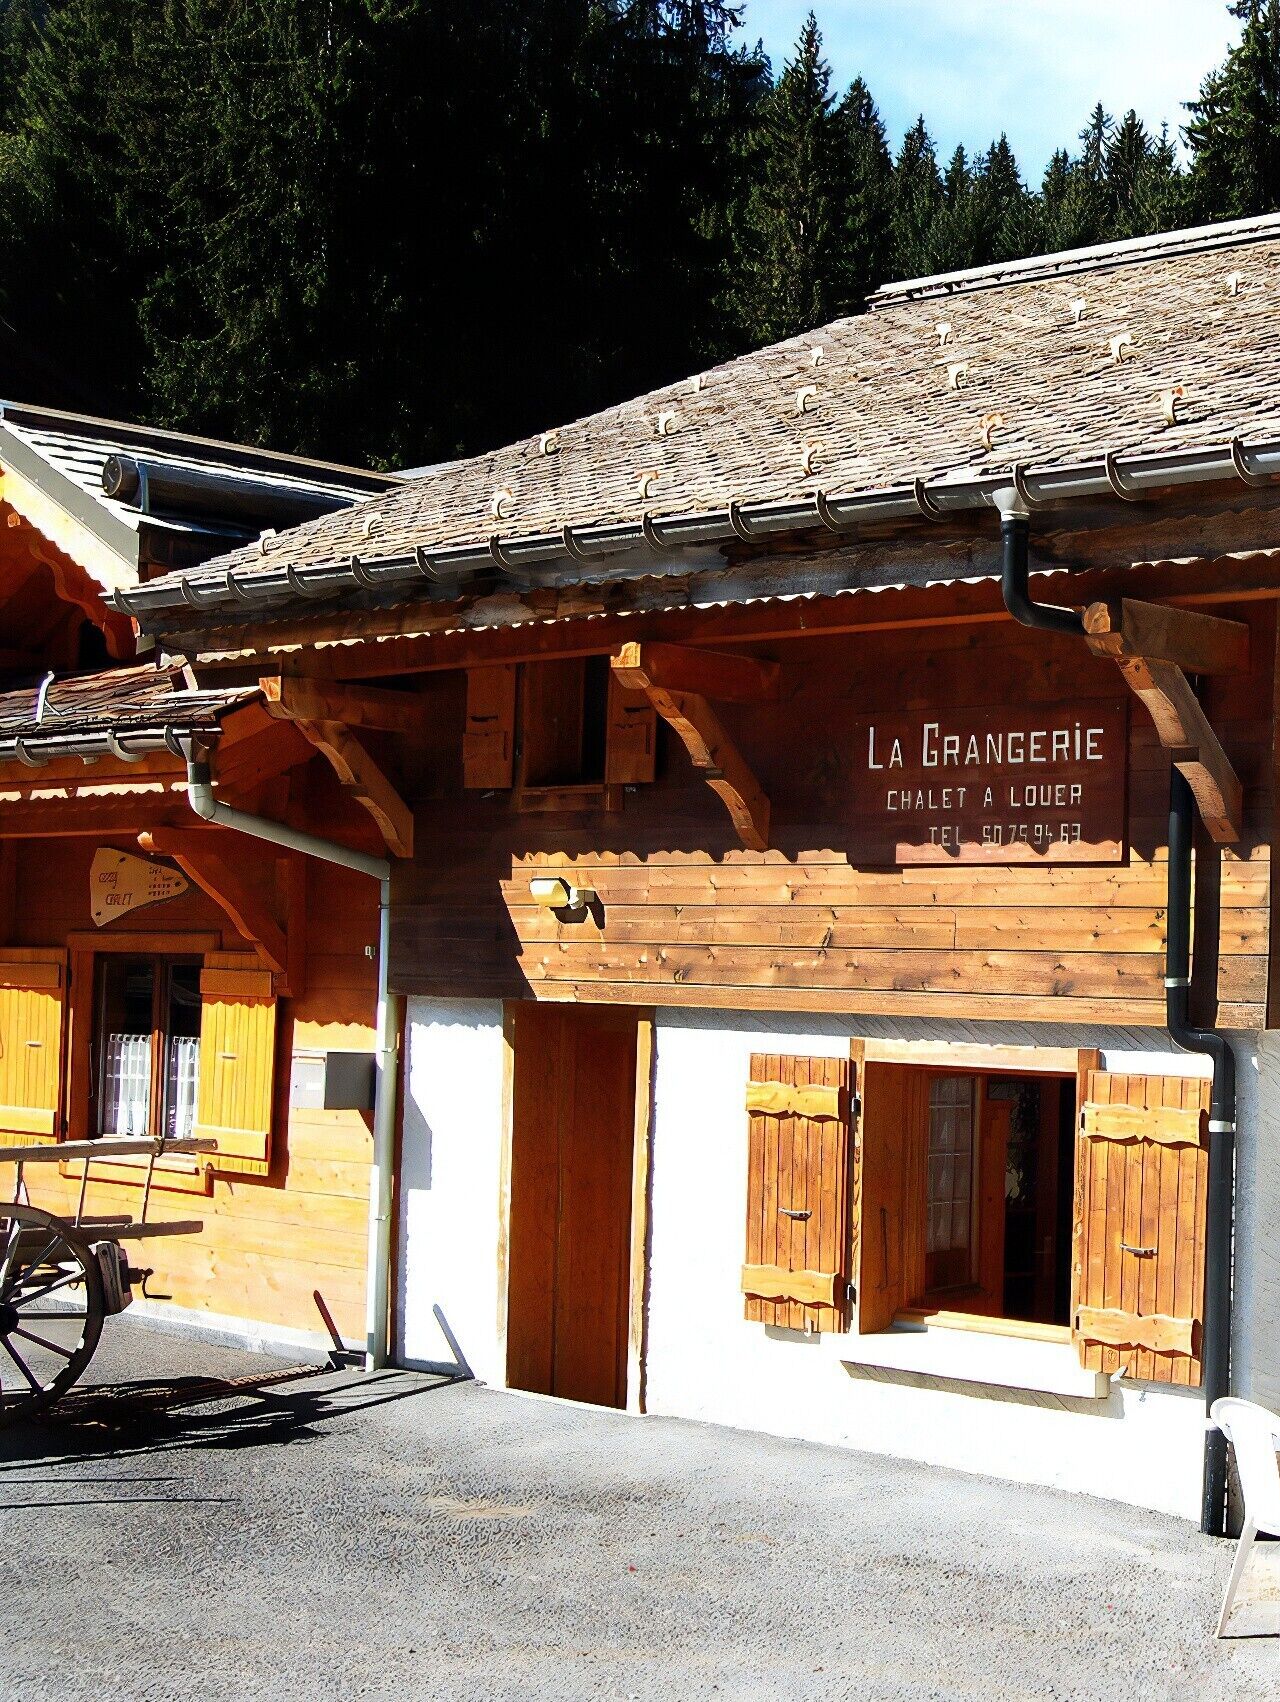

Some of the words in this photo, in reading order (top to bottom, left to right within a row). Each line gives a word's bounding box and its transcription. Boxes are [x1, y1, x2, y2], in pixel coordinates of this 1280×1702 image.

[887, 787, 967, 811] CHALET
[983, 786, 993, 808] A
[1010, 784, 1083, 807] LOUER
[929, 826, 965, 847] TEL
